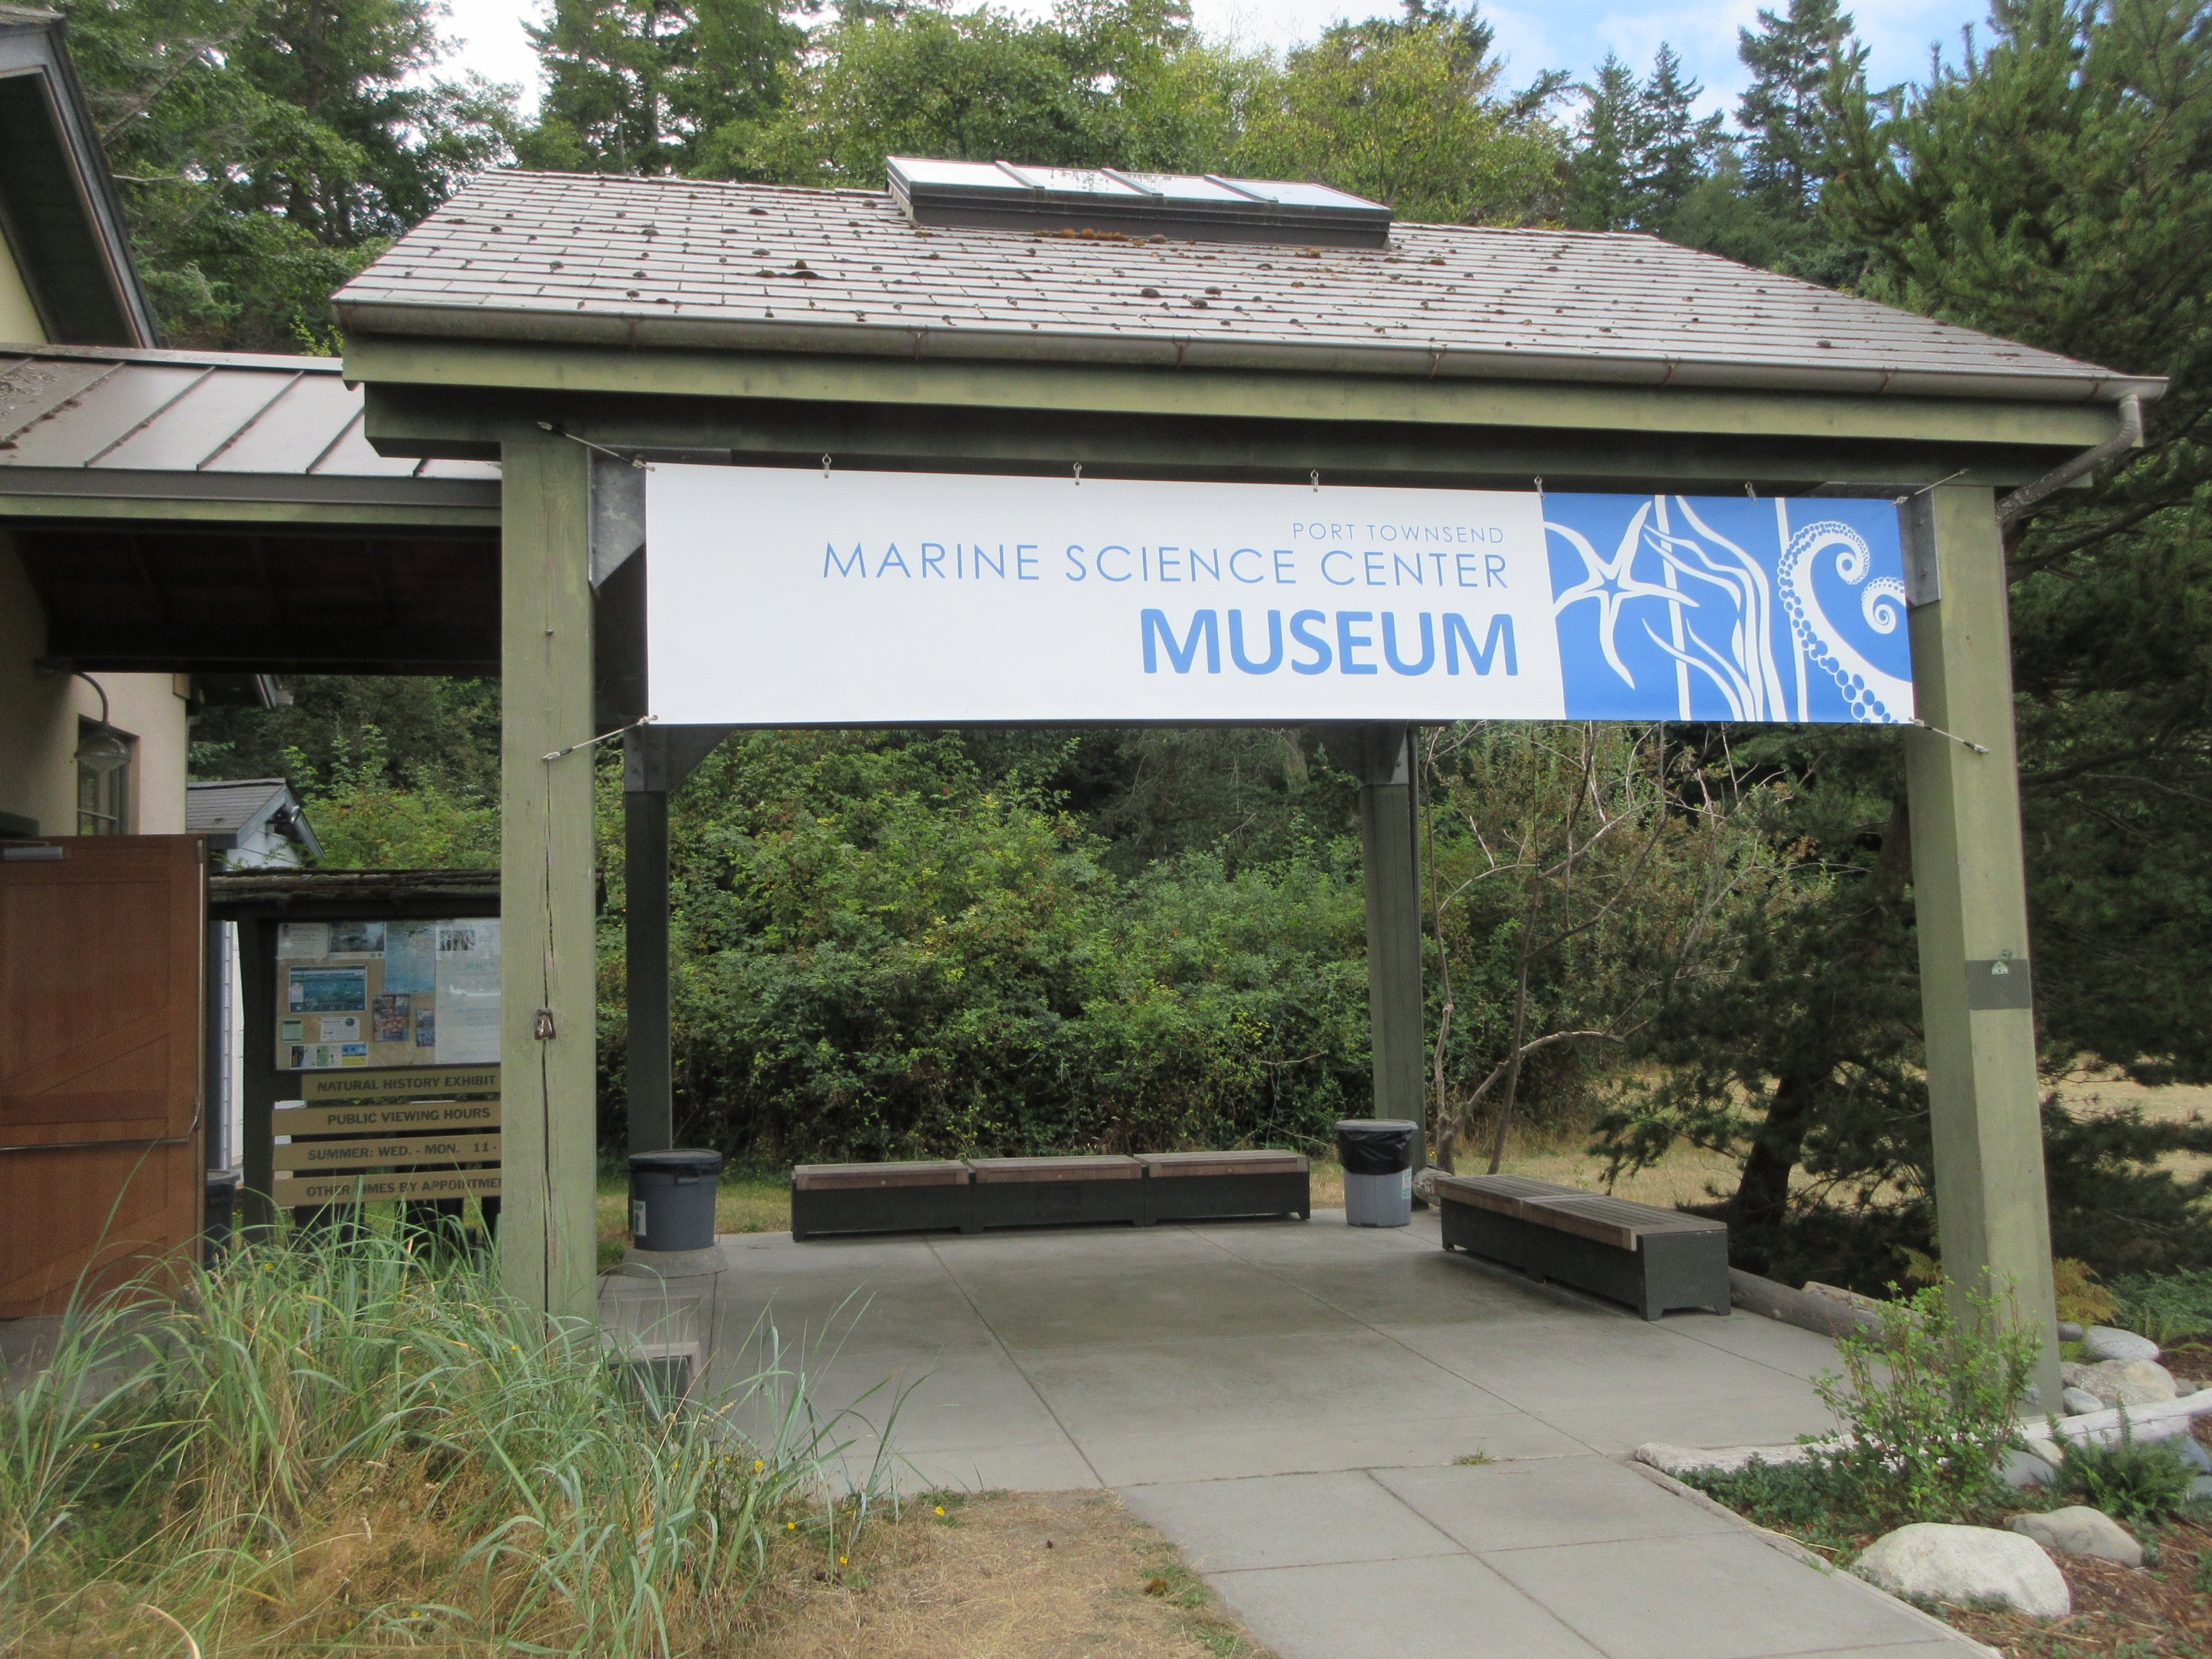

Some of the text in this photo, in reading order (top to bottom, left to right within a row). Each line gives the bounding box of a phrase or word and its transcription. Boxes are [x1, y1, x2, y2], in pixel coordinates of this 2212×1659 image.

[1293, 522, 1504, 544] PORT TOWNSEND
[823, 542, 1508, 588] MARINE SCIENCE CENTER
[1141, 608, 1519, 677] MUSEUM
[317, 1075, 496, 1092] NATURAL HISTORY EXHIBIT
[328, 1108, 491, 1125] PUBLIC VIEWING HOURS
[308, 1147, 373, 1161] SUMMER:
[379, 1146, 412, 1157] WED.
[306, 1185, 350, 1197] OTHER
[356, 1183, 396, 1194] IMES
[399, 1182, 418, 1192] BY
